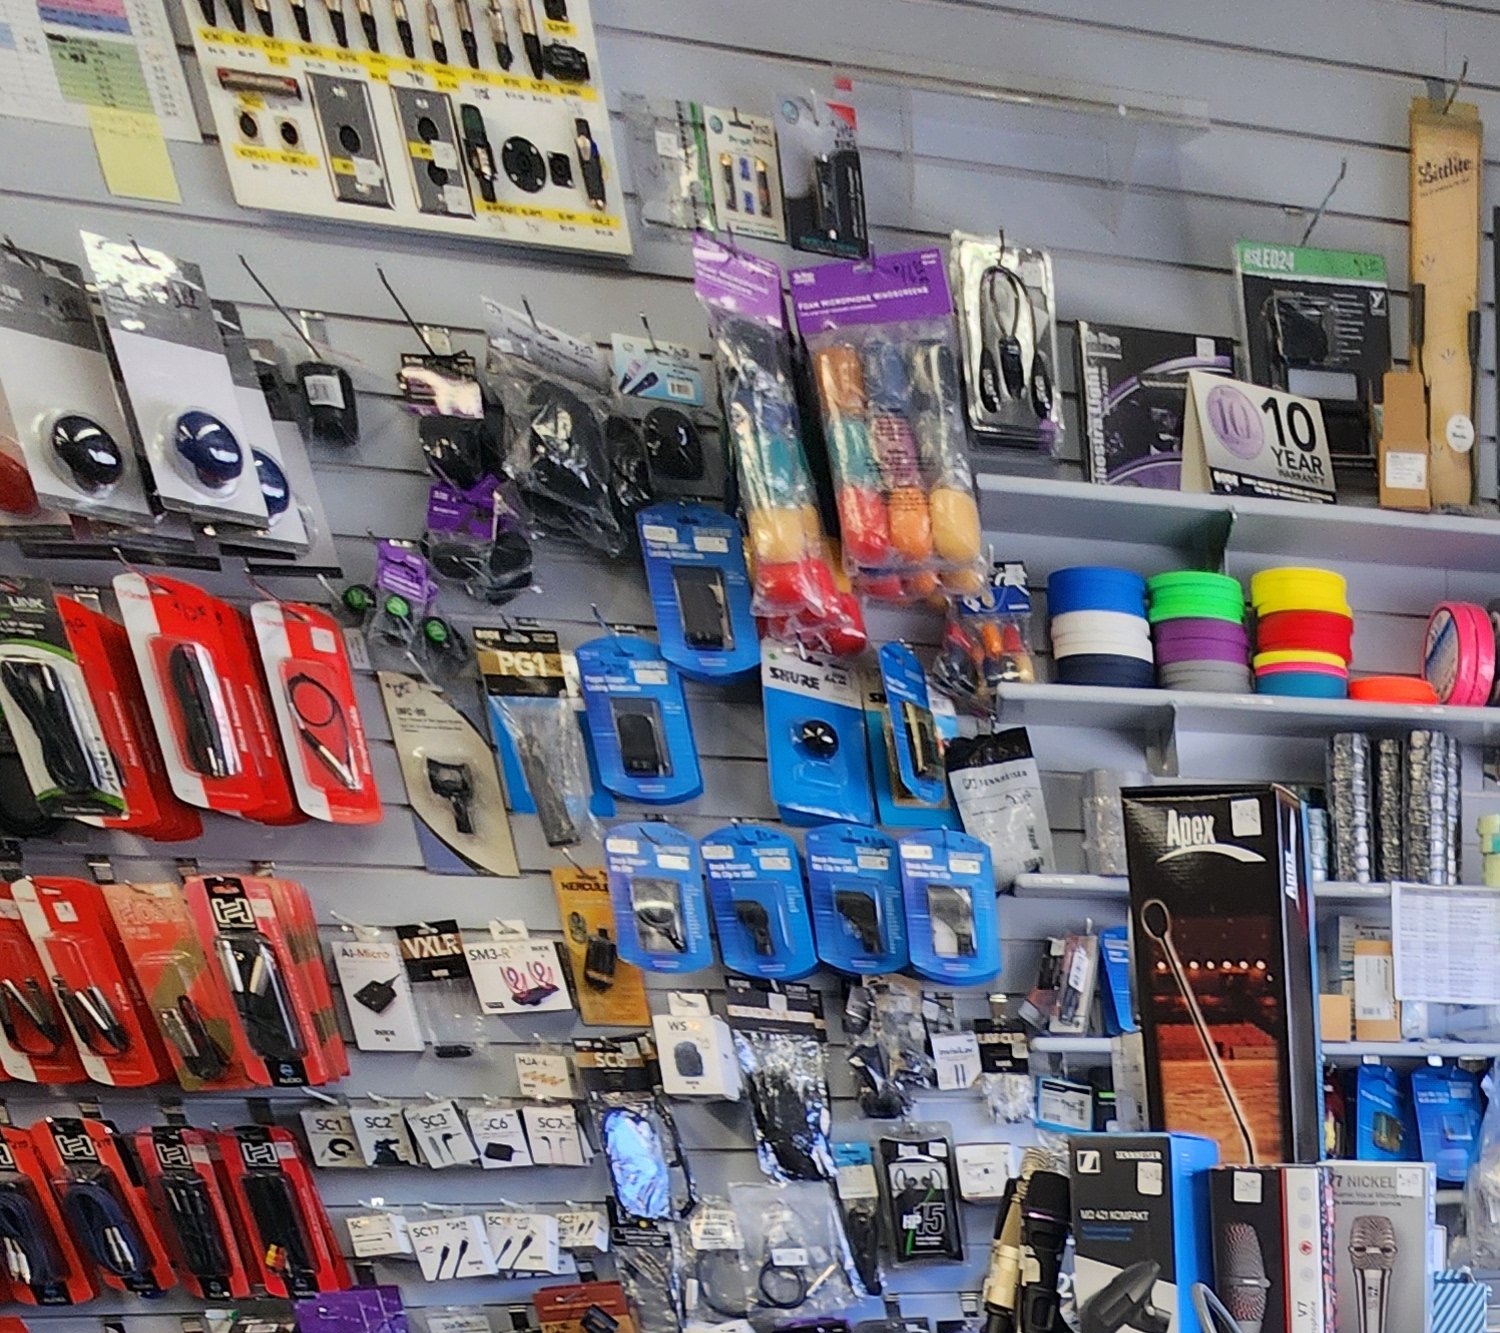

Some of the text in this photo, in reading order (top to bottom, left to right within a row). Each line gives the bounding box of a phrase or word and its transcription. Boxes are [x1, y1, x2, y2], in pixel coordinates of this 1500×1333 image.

[1261, 396, 1316, 452] 10
[1271, 447, 1323, 476] YEAR
[496, 651, 549, 678] PG1
[769, 666, 820, 690] SHURE
[1168, 810, 1215, 847] Apex
[364, 1116, 393, 1129] SC2
[420, 1113, 448, 1129] SC3
[1347, 1176, 1396, 1188] NICKEL
[903, 1215, 921, 1229] HP
[1109, 1209, 1149, 1221] KOMPAKT
